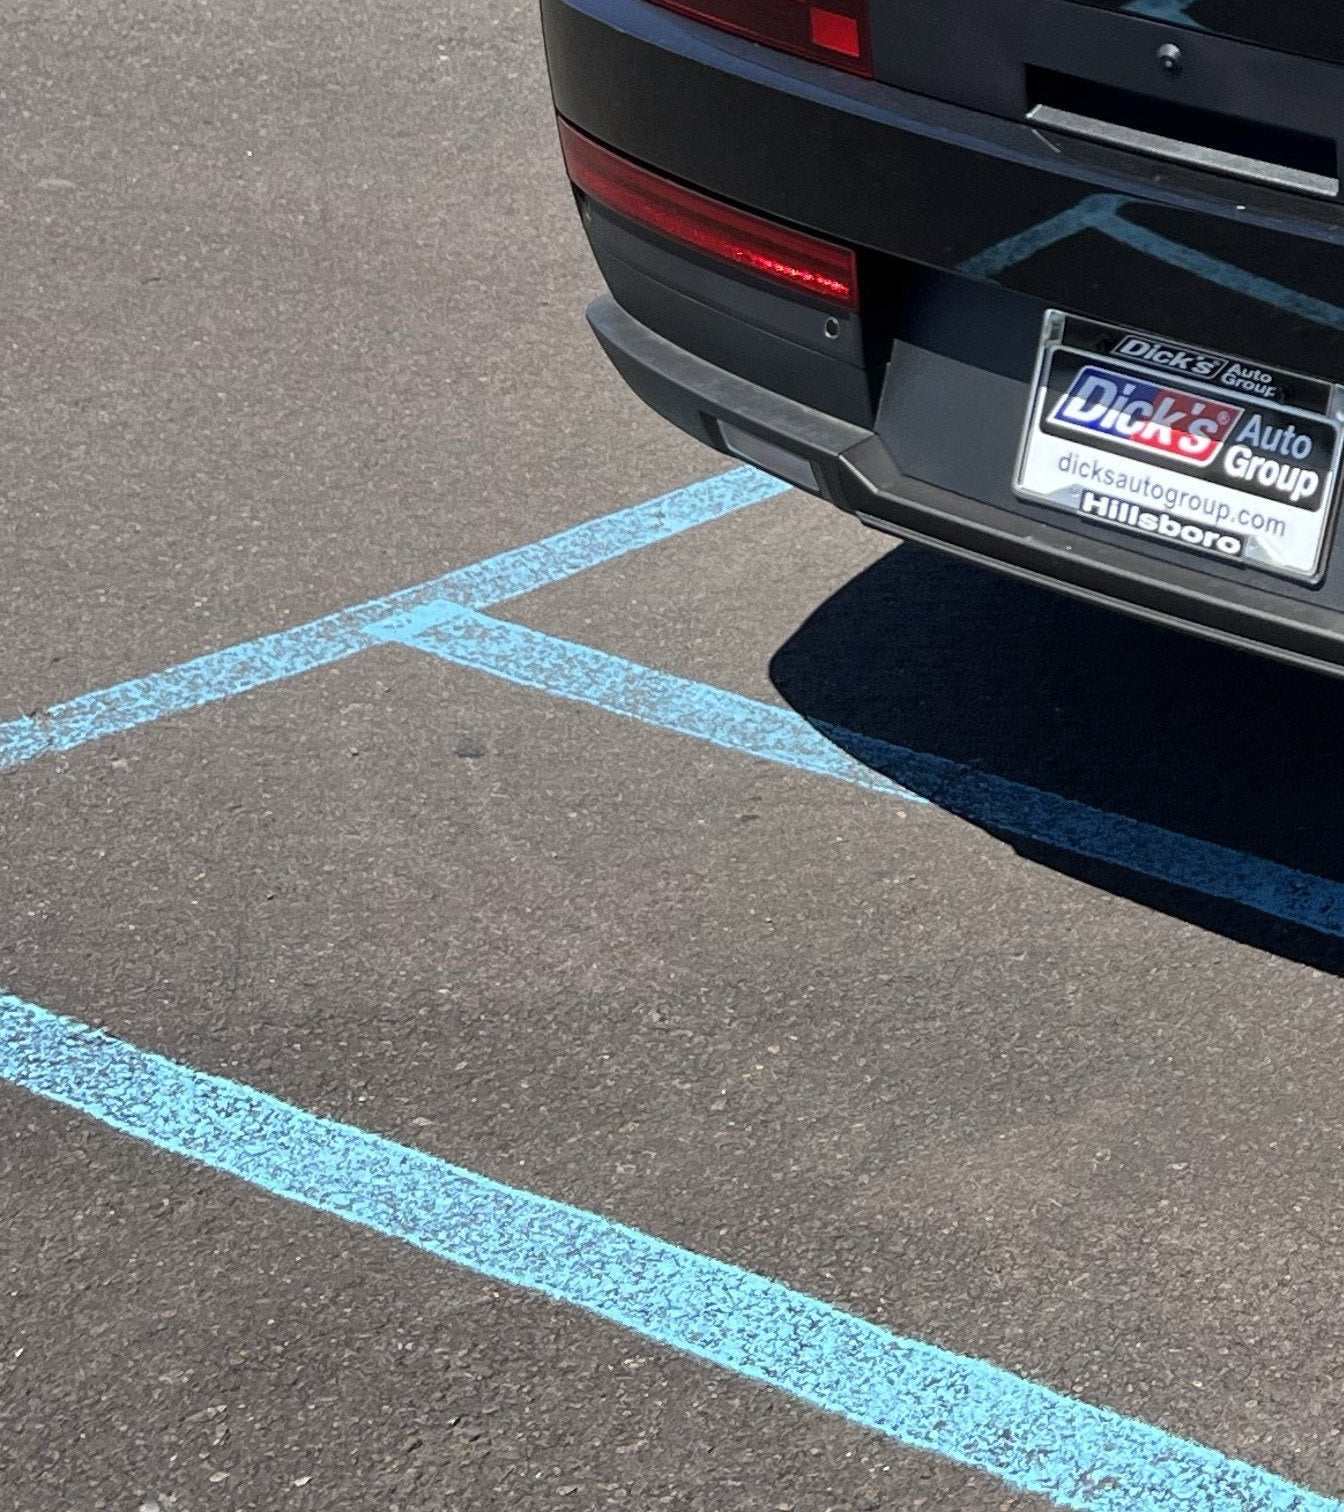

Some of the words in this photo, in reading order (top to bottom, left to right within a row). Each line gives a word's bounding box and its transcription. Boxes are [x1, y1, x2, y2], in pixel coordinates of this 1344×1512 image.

[1226, 362, 1273, 384] Auto
[1236, 413, 1313, 460] Auto
[1057, 451, 1287, 538] dicksautogroup.com
[1223, 444, 1320, 502] Group
[1080, 490, 1242, 556] Hillsboro
